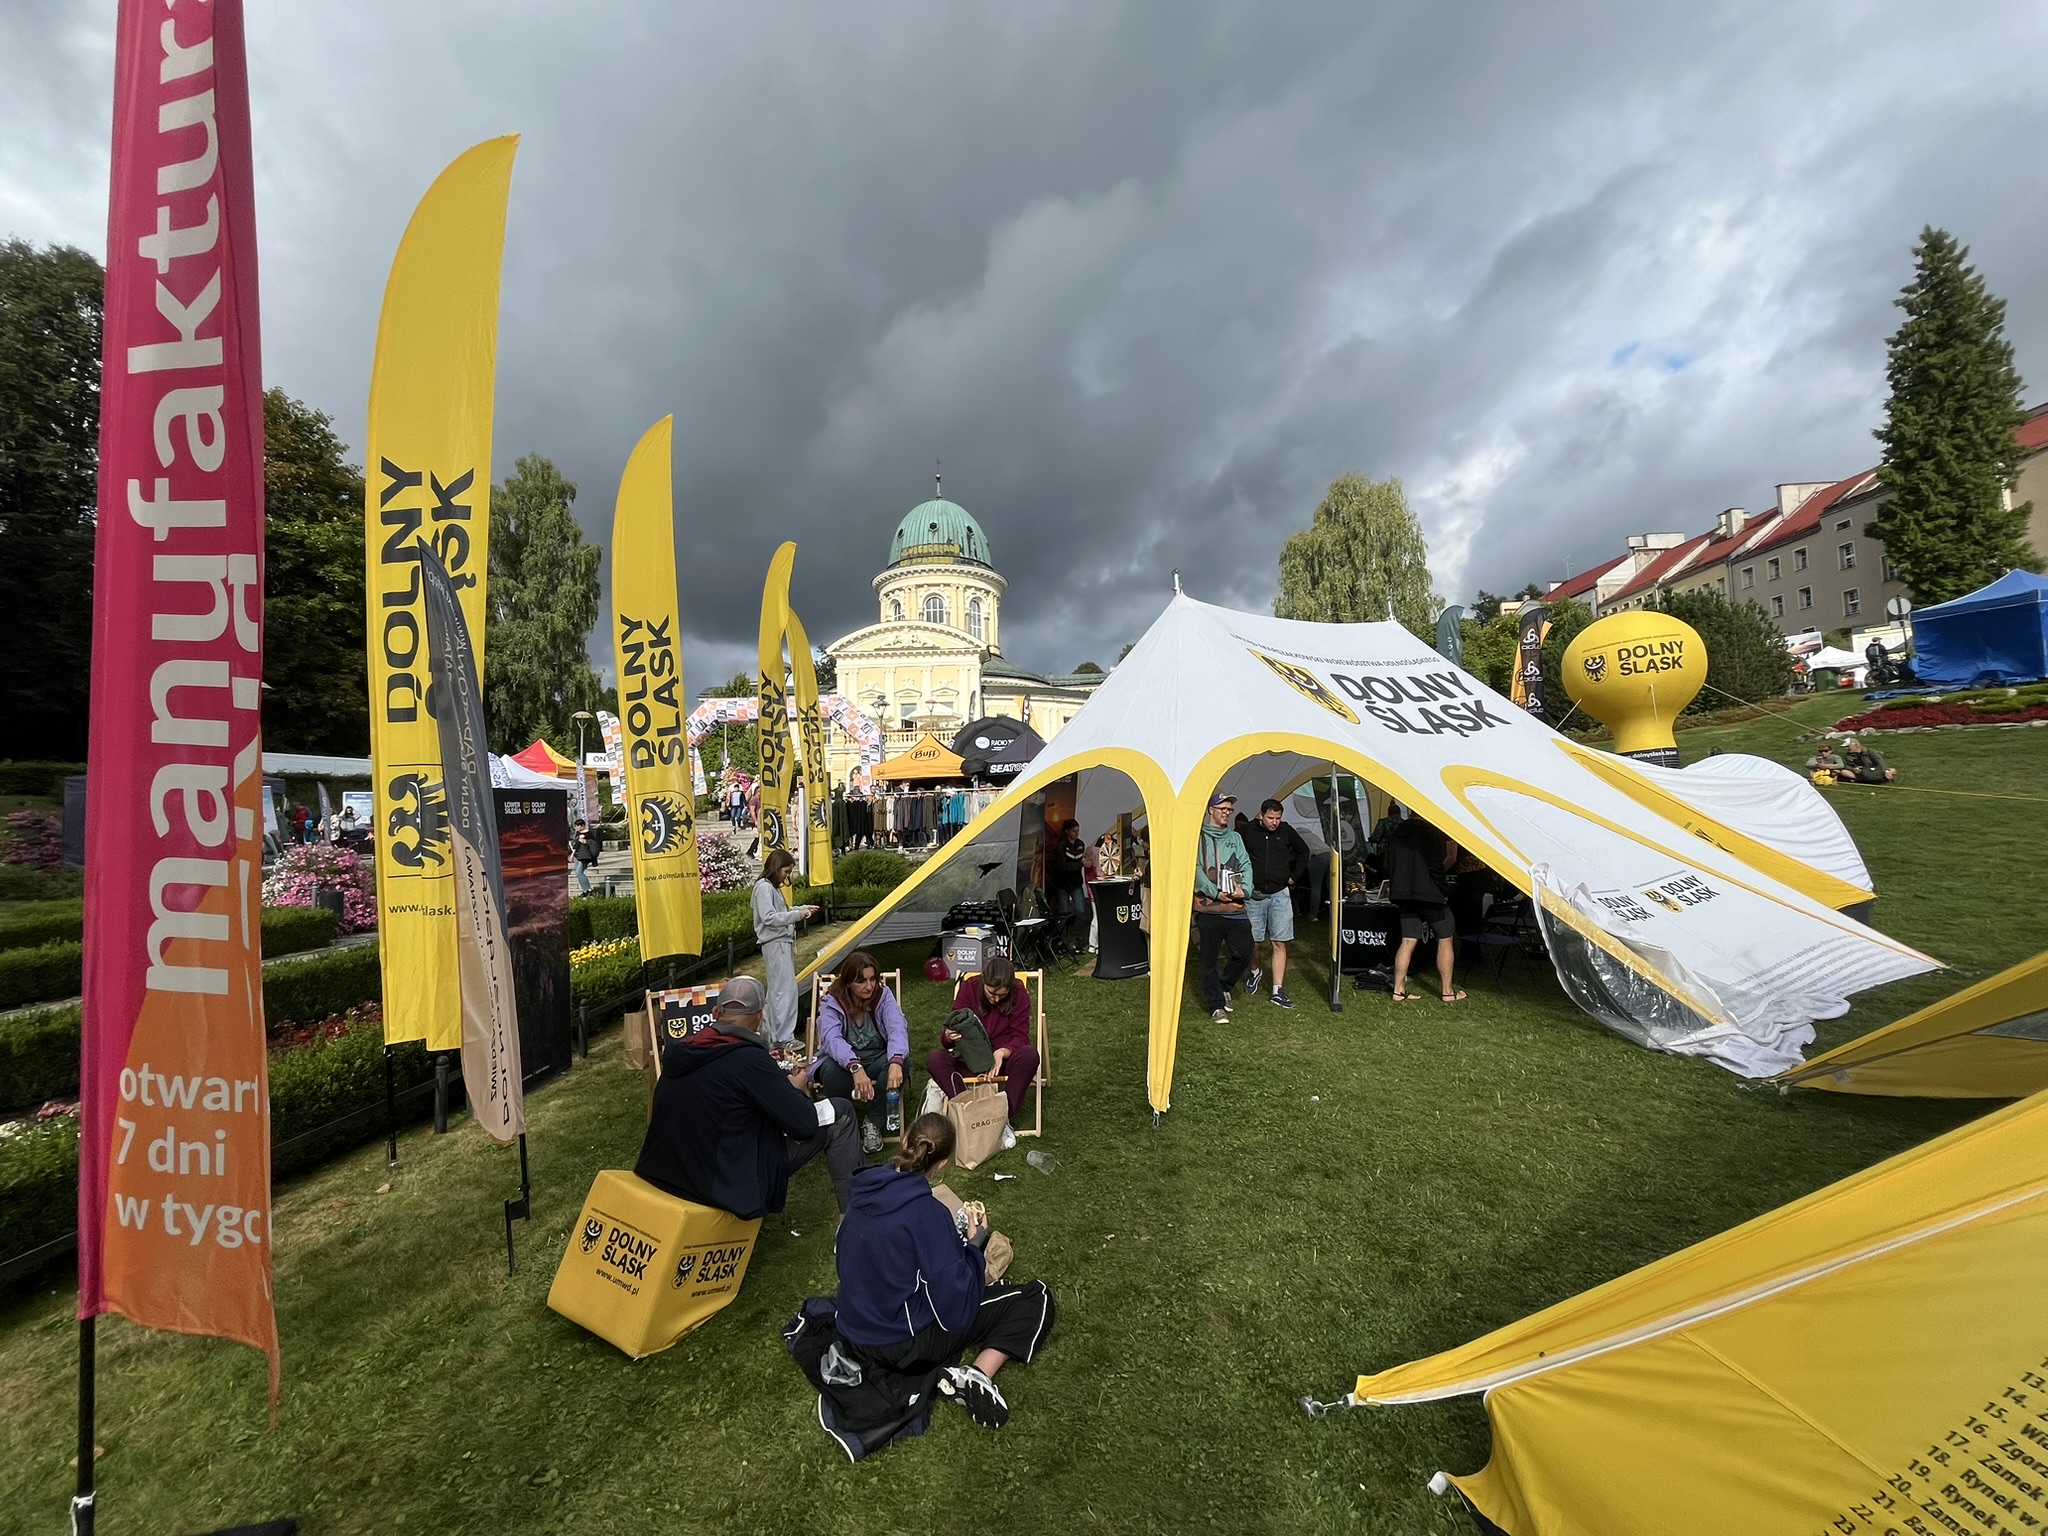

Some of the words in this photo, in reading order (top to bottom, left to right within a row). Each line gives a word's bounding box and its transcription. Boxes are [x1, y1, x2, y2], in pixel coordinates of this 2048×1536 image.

[127, 0, 229, 995] manufaktur
[381, 456, 422, 722] DOLNY
[1617, 640, 1684, 662] DOLNY
[1619, 655, 1684, 677] ŚLĄSK
[620, 613, 655, 769] DOLNY
[647, 614, 684, 766] ŚLĄSK
[1330, 671, 1474, 704] DOLNY
[761, 669, 775, 788] DOLNY
[1364, 700, 1513, 738] ŚLĄSK
[1659, 874, 1705, 896] DOLNY
[1675, 885, 1721, 907] ŚLĄSK
[1357, 930, 1388, 939] DOLNY
[692, 1013, 717, 1025] DOL
[117, 1117, 137, 1165] 7
[148, 1126, 227, 1177] dni
[114, 1192, 150, 1231] w
[608, 1227, 659, 1263] DOLNY
[701, 1246, 747, 1266] DOLNY
[601, 1242, 648, 1281] ŚLĄSK
[695, 1262, 738, 1284] ŚLĄSK
[595, 1267, 640, 1296] www.umwd.pl
[690, 1283, 732, 1298] www.umwd.pl
[2020, 1371, 2047, 1394] 13.
[2001, 1386, 2027, 1409] 14.
[1964, 1415, 1989, 1439] 16.
[1982, 1401, 2008, 1424] 15.
[1945, 1430, 1971, 1454] 17.
[1977, 1453, 2045, 1502] Zamek
[1907, 1458, 1931, 1484] 19.
[1940, 1483, 1999, 1530] Rynek
[1926, 1445, 1951, 1468] 18.
[1959, 1468, 2020, 1514] Rynek
[2019, 1511, 2040, 1527] w
[1848, 1503, 1875, 1525] 22.
[1872, 1489, 1896, 1515] 21.
[1886, 1472, 1912, 1499] 20.
[1920, 1497, 1981, 1536] Zame
